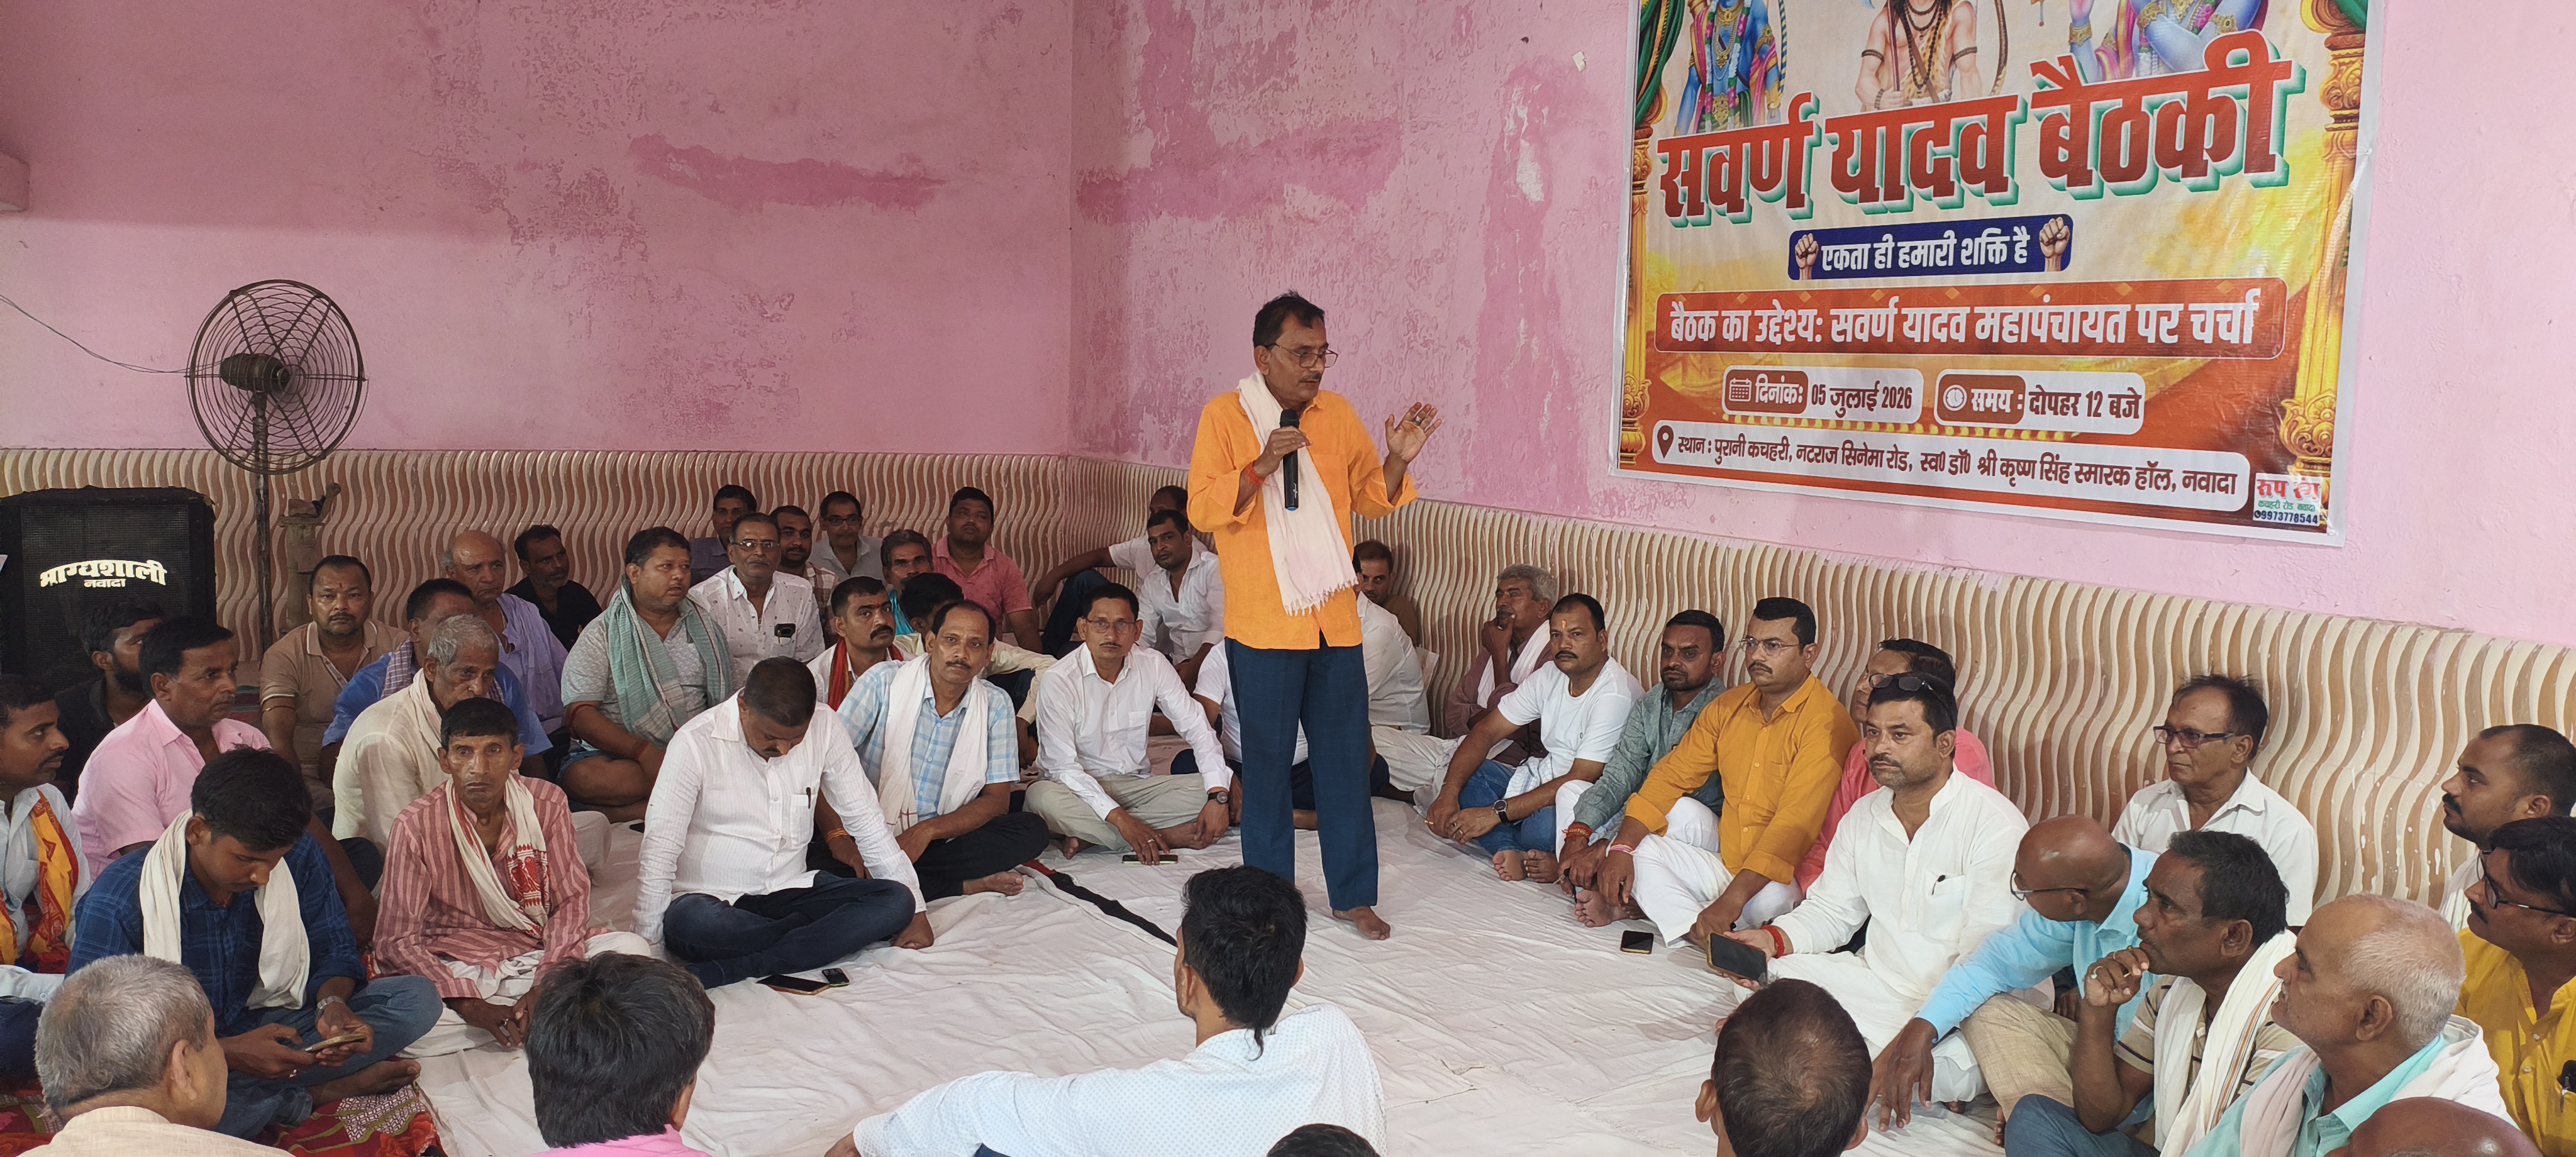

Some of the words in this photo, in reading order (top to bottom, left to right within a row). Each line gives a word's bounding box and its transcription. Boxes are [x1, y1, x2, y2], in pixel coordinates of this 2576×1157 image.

[1657, 91, 1821, 228] सवर्ण
[1825, 94, 2028, 215] यादव
[2030, 28, 2306, 201] बैठकी
[1821, 243, 1871, 270] एकता
[1874, 234, 1894, 268] ही
[1897, 230, 1957, 267] हमारी
[1961, 228, 2010, 265] शक्ति
[2012, 226, 2030, 263] है
[1670, 301, 1719, 341] बैठक
[1721, 310, 1752, 341] का
[1755, 299, 1823, 345] उद्देश्य:
[1830, 296, 1899, 342] सवर्ण
[1901, 306, 1970, 343] यादव
[1974, 294, 2130, 343] महापंचायत
[2135, 304, 2184, 343] पर
[2189, 288, 2261, 344] चर्चा
[1755, 374, 1803, 404] दिनांक:
[1811, 384, 1826, 406] 05
[1829, 380, 1880, 418] जुलाई
[1882, 387, 1912, 409] 2026
[1971, 389, 2014, 413] समय
[2029, 385, 2081, 417] दोपहर
[2085, 390, 2103, 418] 12
[2108, 387, 2141, 419] बजे
[1678, 436, 1706, 454] स्थान
[1714, 433, 1746, 465] पुरानी
[1748, 436, 1792, 462] कचहरी,
[1796, 444, 1840, 464] नटराज
[1841, 440, 1884, 468] सिनेमा
[1886, 446, 1913, 472] रोड,
[1977, 449, 1997, 476] श्री
[1999, 457, 2036, 487] कृष्ण
[2040, 452, 2072, 485] सिंह
[2074, 462, 2131, 486] स्मारक
[2135, 461, 2177, 492] हॉल,
[2182, 470, 2237, 495] नवादा
[2261, 511, 2318, 524] 9973778544
[84, 578, 126, 588] नवादा
